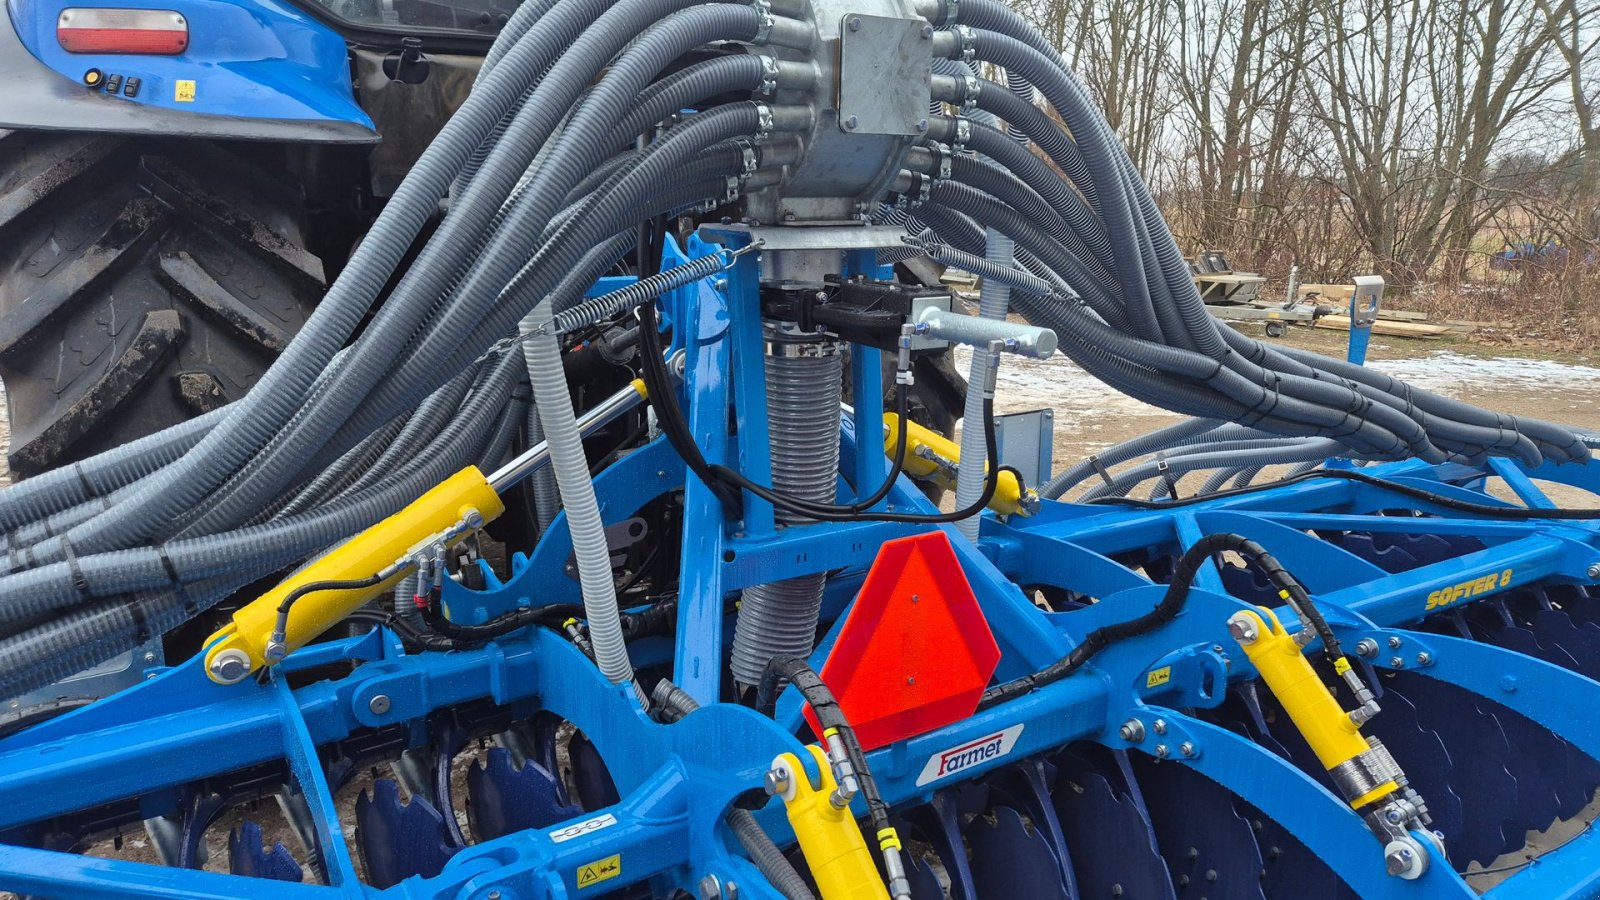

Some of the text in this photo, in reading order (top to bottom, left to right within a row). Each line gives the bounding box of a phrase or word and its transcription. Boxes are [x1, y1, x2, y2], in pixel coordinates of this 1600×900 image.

[1425, 568, 1512, 610] SOFTER 8
[938, 733, 1004, 776] Farmet
